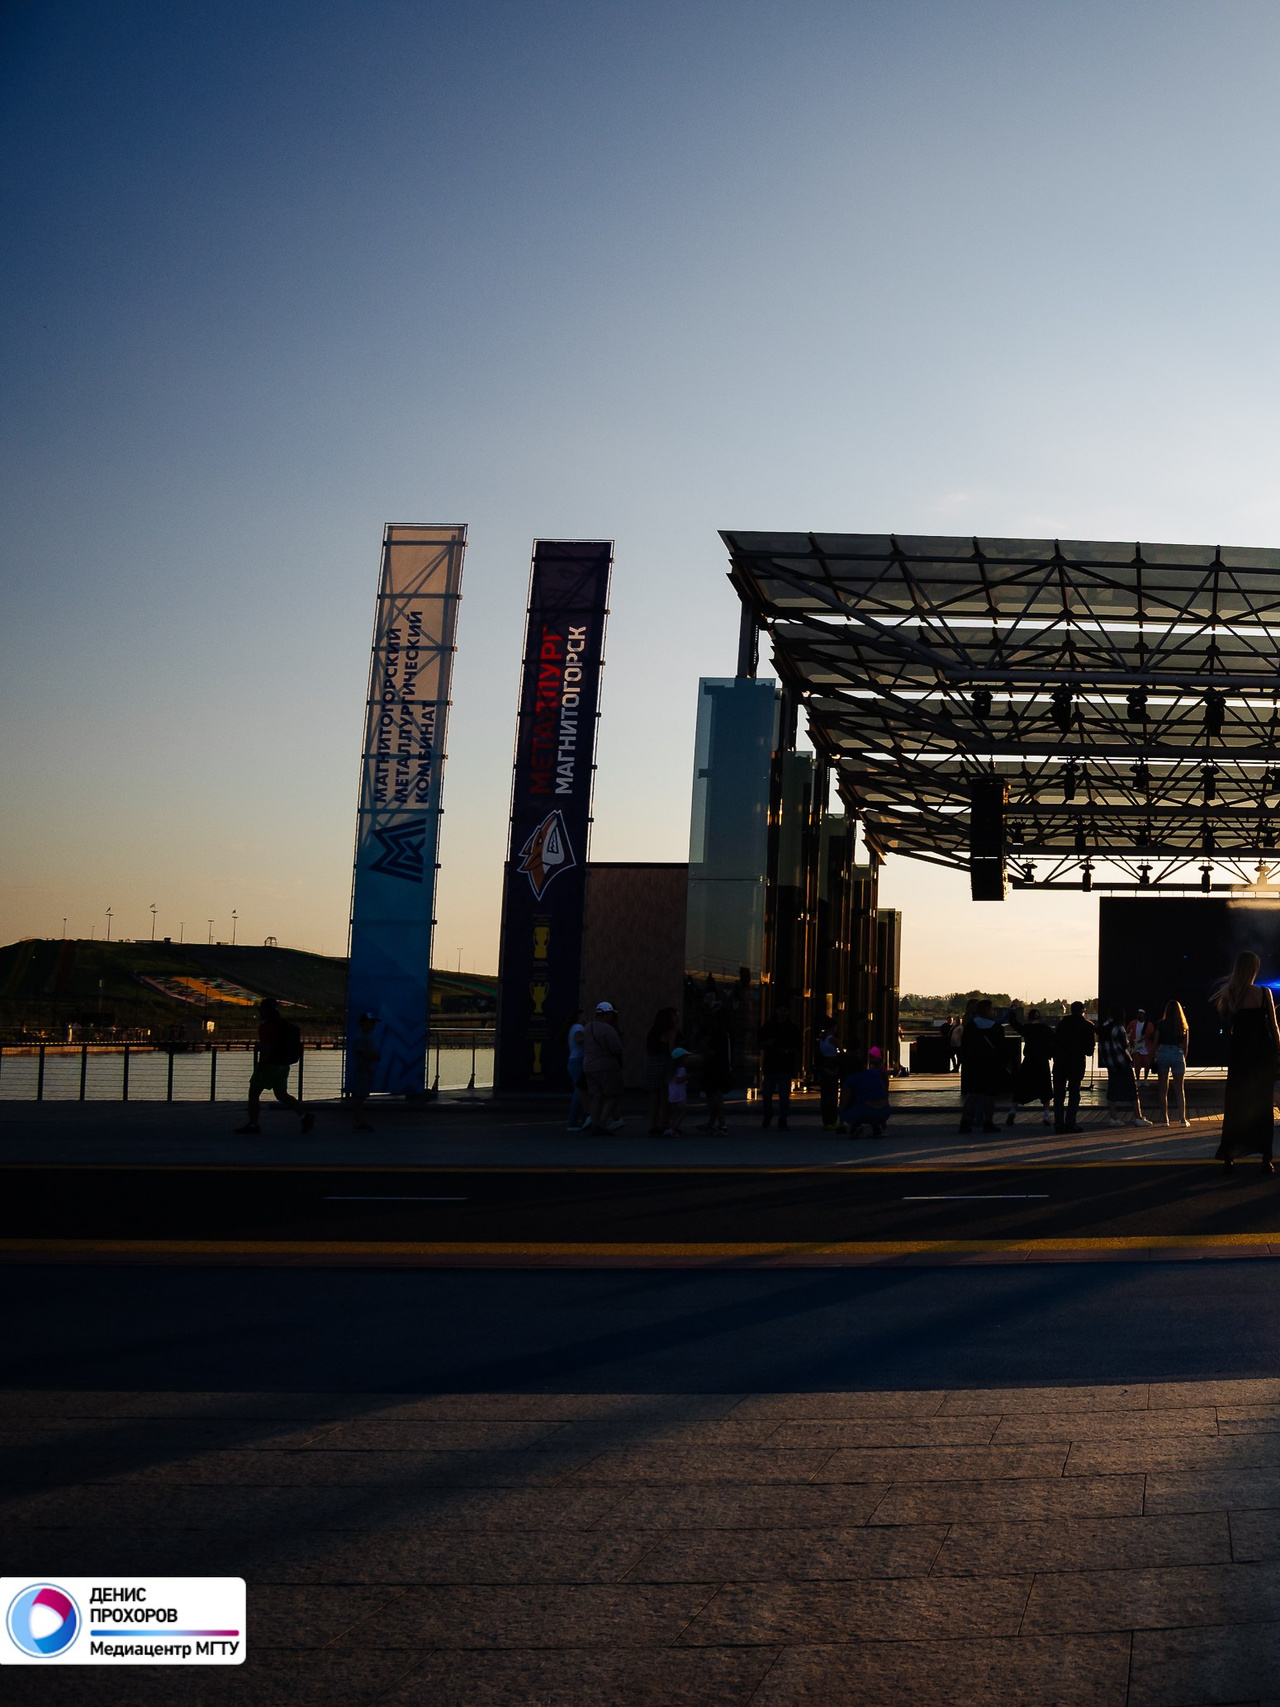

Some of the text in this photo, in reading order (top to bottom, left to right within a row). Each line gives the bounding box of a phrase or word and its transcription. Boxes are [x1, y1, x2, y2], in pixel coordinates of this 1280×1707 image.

[374, 629, 402, 803] МАГНИТОГОРСКИЙ
[395, 611, 423, 804] МЕТАЛЛУРГИЧЕСКИЙ
[415, 699, 437, 804] КОМБИНАТ
[528, 626, 564, 795] МЕТАЛЛУРГ
[554, 626, 587, 795] МАГНИТОГОРСК
